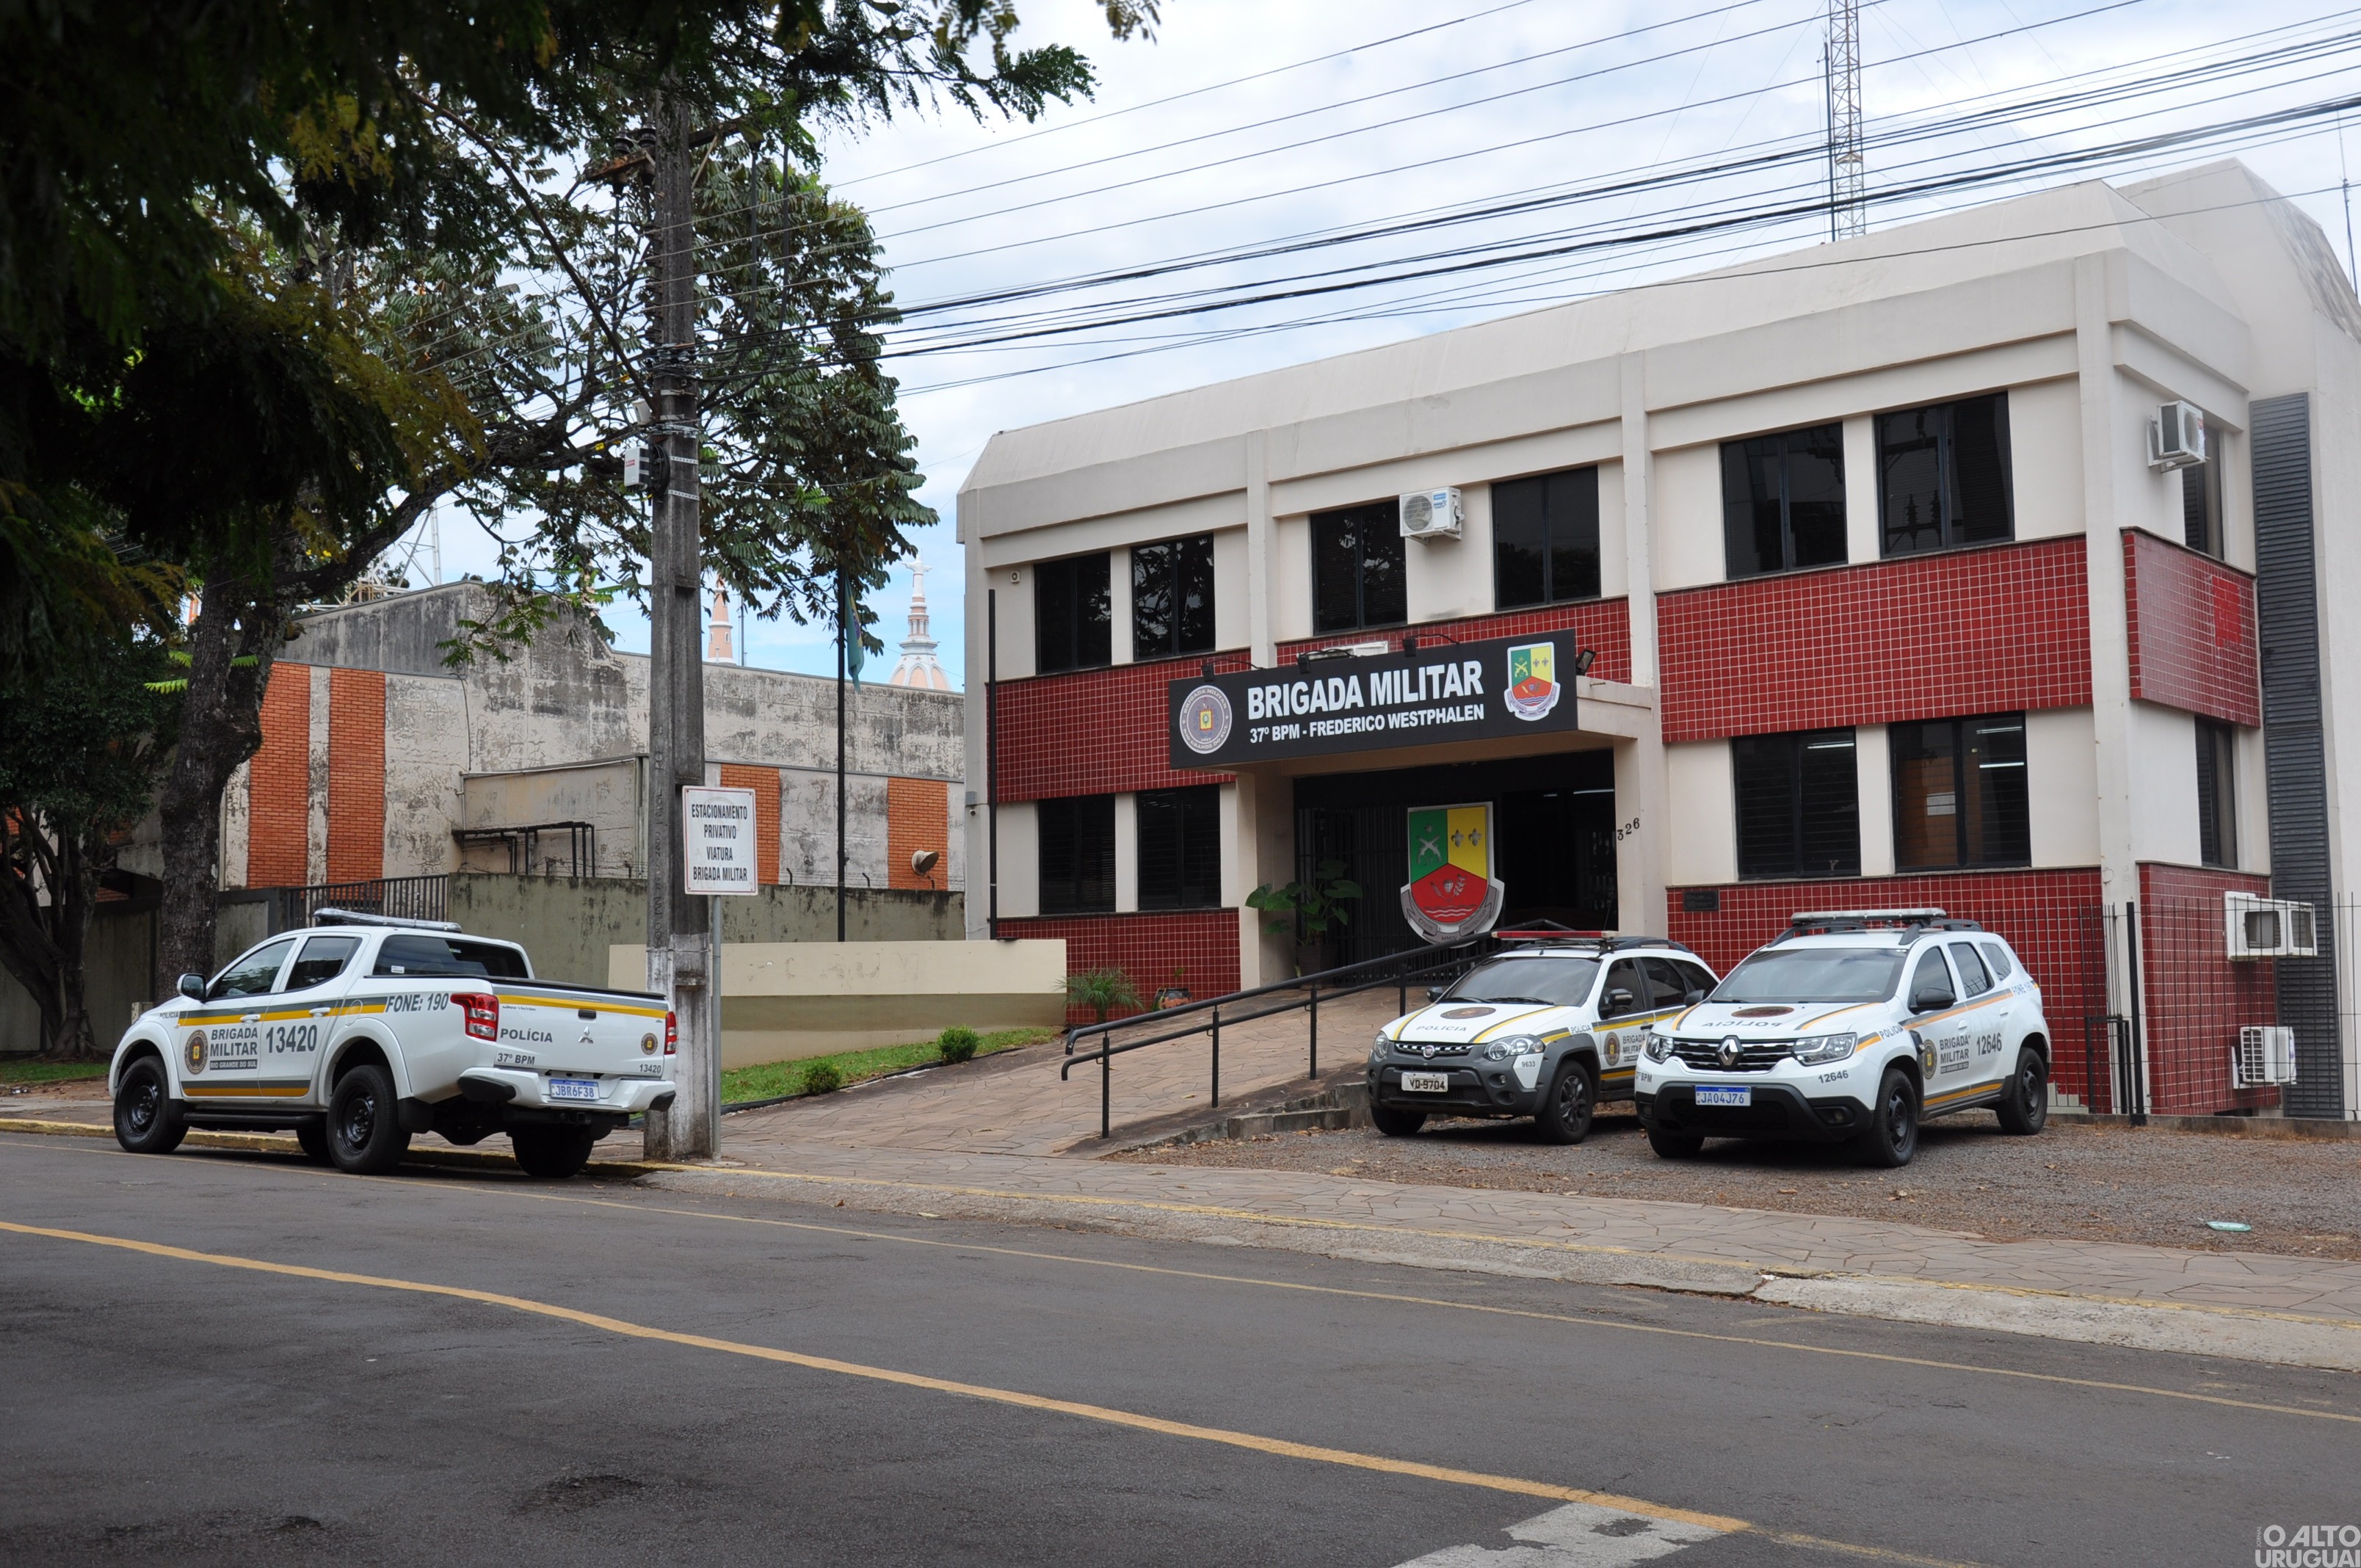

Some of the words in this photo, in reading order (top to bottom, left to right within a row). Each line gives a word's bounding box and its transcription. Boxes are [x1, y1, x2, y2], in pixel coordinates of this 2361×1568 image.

[1248, 675, 1364, 719] BRIGADA
[1370, 661, 1484, 706] MILITAR
[1183, 689, 1205, 714] BRIGADA
[1207, 689, 1227, 709] MILITAR
[1272, 724, 1299, 741] BPM
[1310, 714, 1385, 737] FREDERICO
[1388, 703, 1484, 729] WESTPHALEN
[692, 804, 747, 820] ESTACIONAMENTO
[704, 824, 736, 839] PRIVATIVO
[706, 846, 733, 860] VIATURA
[693, 866, 720, 880] BRIGADA
[722, 868, 747, 881] MILITAR
[385, 994, 423, 1013] FONE:
[427, 992, 449, 1011] 190
[211, 1028, 258, 1040] BRIGADA
[266, 1025, 317, 1053] 13420
[500, 1028, 552, 1042] POLÍCIA
[1622, 1034, 1645, 1044] BRIGADA
[210, 1042, 258, 1056] MILITAR
[1940, 1035, 1969, 1050] BRIGADA
[1976, 1032, 2002, 1056] 12646
[515, 1055, 535, 1065] BPM
[1940, 1048, 1969, 1064] MILITAR
[639, 1064, 661, 1073] 13420
[1641, 1072, 1652, 1083] BPM
[1818, 1070, 1849, 1084] 12646
[556, 1086, 594, 1097] JBR6F38
